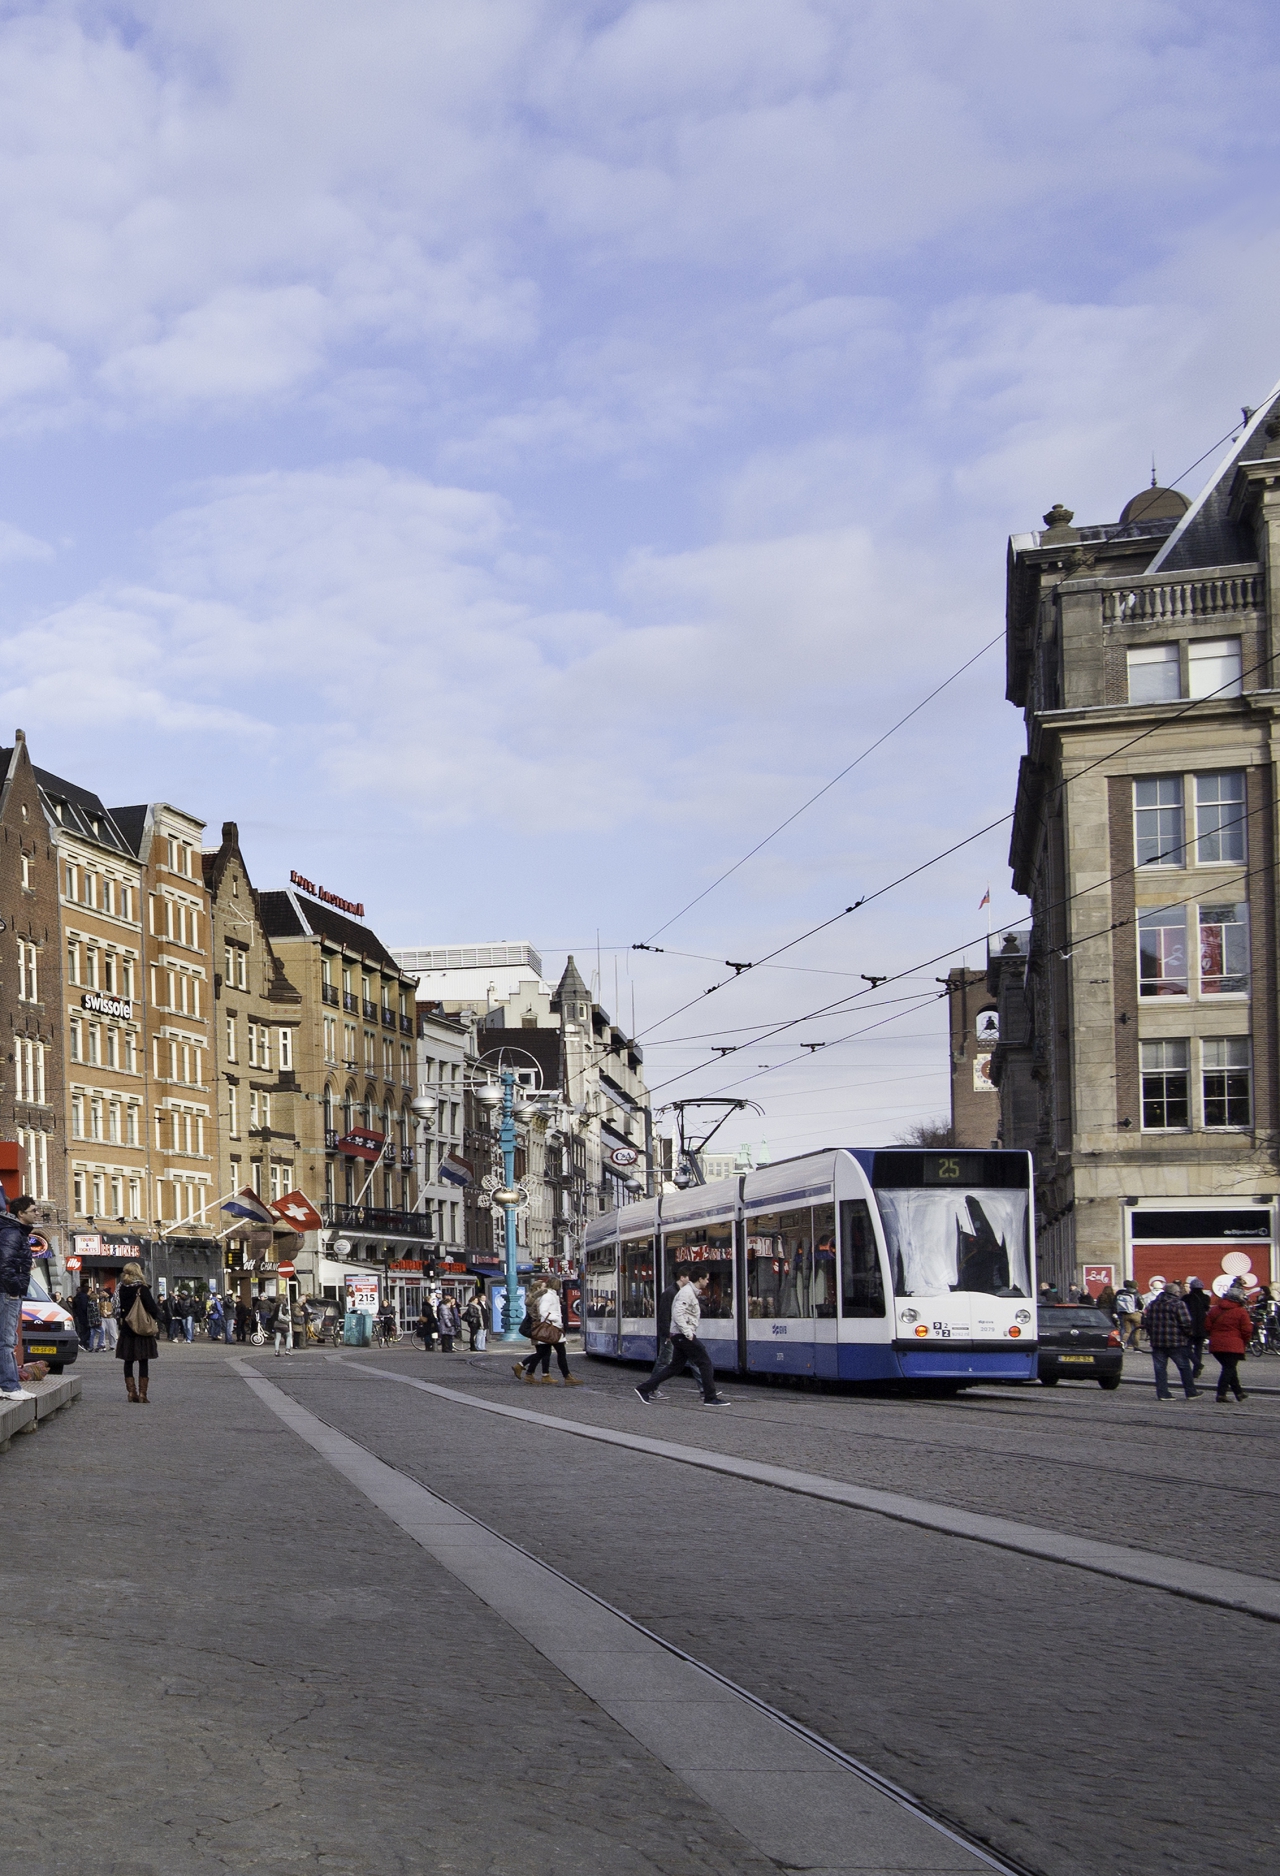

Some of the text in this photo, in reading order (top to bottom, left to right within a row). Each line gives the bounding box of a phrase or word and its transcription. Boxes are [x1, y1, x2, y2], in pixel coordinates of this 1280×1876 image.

[615, 1152, 634, 1161] C&A
[939, 1158, 959, 1178] 25
[117, 1245, 140, 1258] TICKETS
[67, 1258, 81, 1270] illy
[359, 1293, 375, 1302] 215
